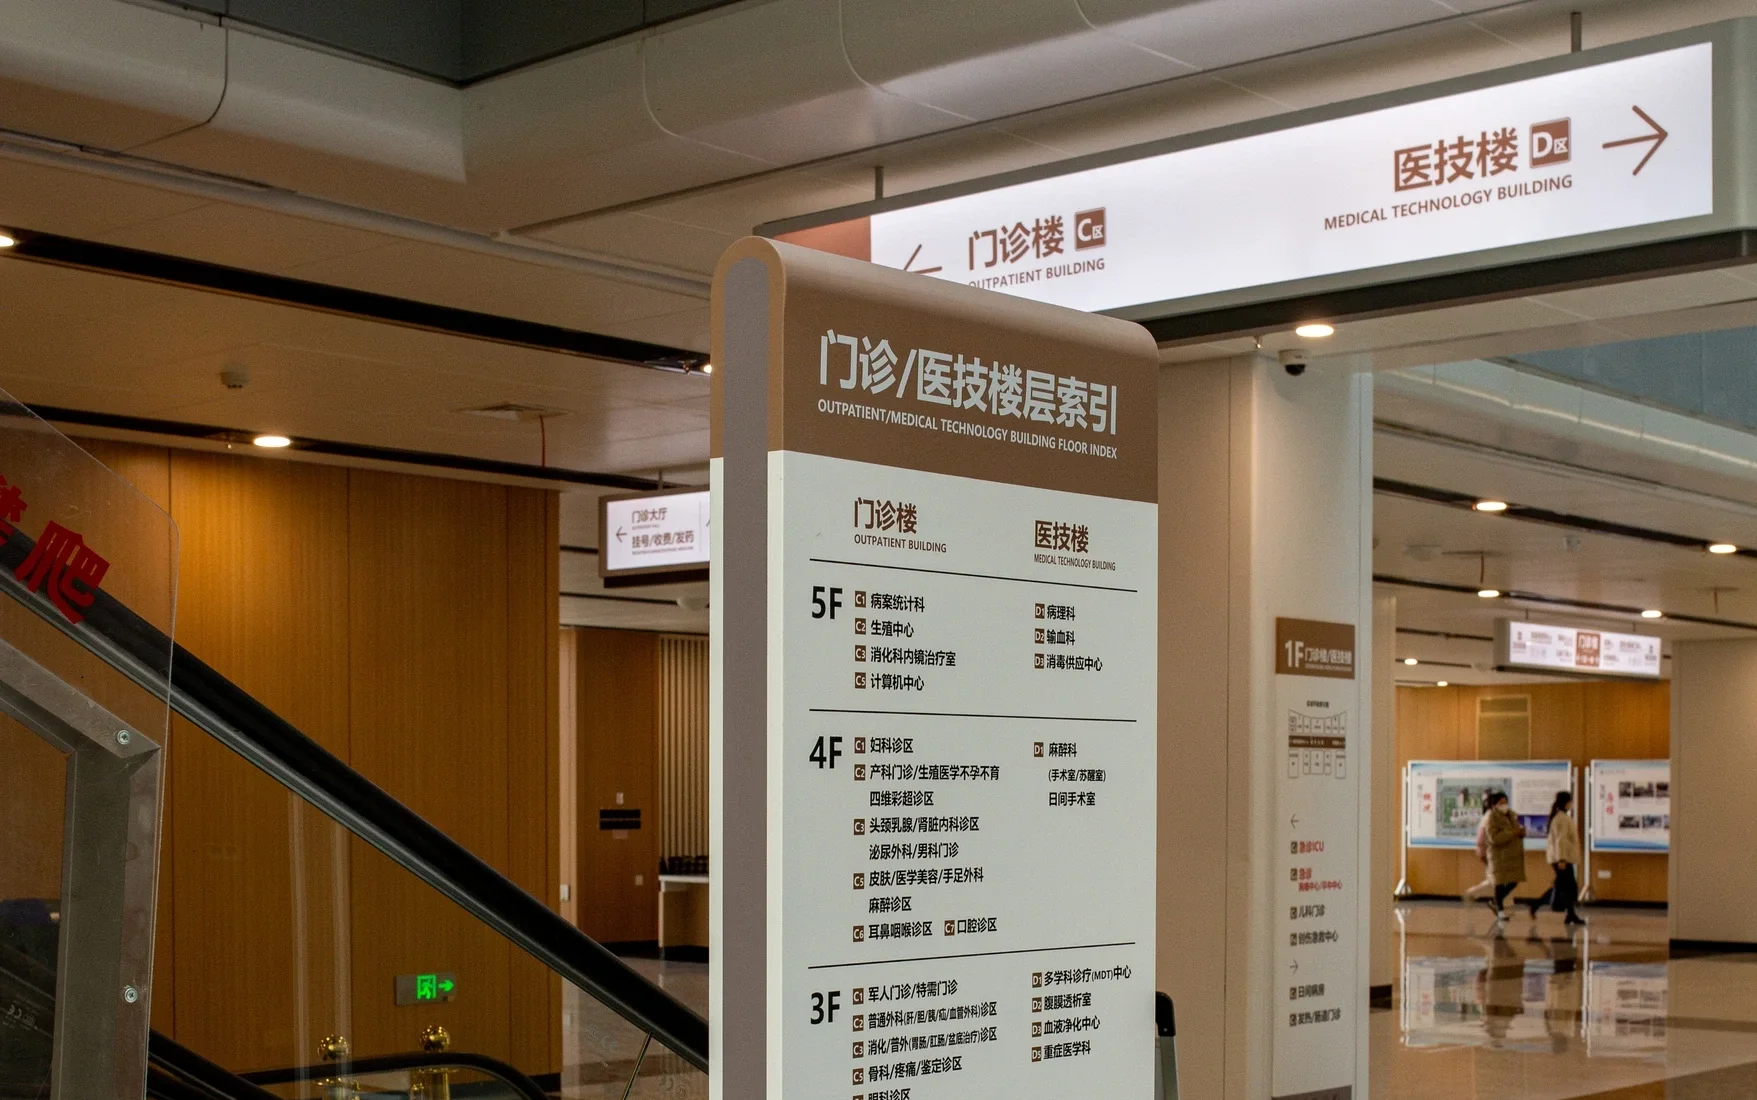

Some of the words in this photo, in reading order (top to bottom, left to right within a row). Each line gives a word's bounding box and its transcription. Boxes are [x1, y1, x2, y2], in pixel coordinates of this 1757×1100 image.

[1394, 128, 1518, 192] 医技楼
[1324, 208, 1387, 230] MEDICAL
[1392, 190, 1492, 218] TECHNOLOGY
[1498, 175, 1572, 200] BUILDING
[968, 215, 1064, 271] 门诊楼
[1046, 258, 1105, 278] BUILDING
[820, 329, 1117, 435] 门诊/医技楼层索引
[818, 399, 938, 430] OUTPATIENT/MEDICAL
[940, 418, 1008, 442] TECHNOLOGY
[1010, 430, 1056, 449] BUILDING
[1058, 438, 1088, 454] FLOOR
[1090, 444, 1118, 459] INDEX
[632, 508, 667, 524] 门诊大厅
[854, 497, 917, 534] 门诊楼
[632, 530, 694, 548] 挂号/收费/发药
[854, 534, 906, 549] OUTPATIENT
[908, 540, 946, 552] BUILDING
[1034, 520, 1088, 554] 医技楼
[1034, 554, 1056, 565] MEDICAL
[1058, 556, 1091, 569] TECHNOLOGY
[1092, 560, 1116, 571] BUILDING
[812, 586, 842, 619] 5F
[870, 593, 925, 612] 病案统计科
[1046, 605, 1076, 621] 病理科
[870, 620, 914, 638] 生殖中心
[1046, 630, 1076, 646] 输血科
[870, 647, 956, 666] 消化科内镜治疗室
[1046, 654, 1102, 672] 消毒供应中心
[1285, 640, 1304, 668] 1F
[870, 674, 924, 691] 计算机中心
[809, 736, 842, 769] 4F
[870, 738, 914, 754] 妇科诊区
[1048, 742, 1077, 757] 麻醉科
[870, 764, 1000, 780] 产科门诊/生殖医学不孕不育
[1048, 769, 1106, 782] (手术室/苏醒室)
[870, 790, 934, 806] 四维彩超诊区
[1049, 792, 1096, 806] 日间手术室
[870, 816, 979, 833] 头颈乳腺/肾脏内科诊区
[870, 842, 959, 860] 泌尿外科/男科门诊
[869, 866, 984, 887] 皮肤/医学美容/手足外科
[868, 896, 912, 914] 麻醉诊区
[868, 922, 932, 940] 耳鼻咽喉诊区
[958, 918, 997, 934] 口腔诊区
[1044, 965, 1132, 986] 多学科诊疗(MDT)中心
[868, 979, 958, 1002] 军人门诊/特需门诊
[810, 991, 840, 1024] 3F
[1044, 1015, 1100, 1034] 血液净化中心
[1044, 1040, 1091, 1060] 重症医学科
[868, 1056, 962, 1082] 骨科/疼痛/鉴定诊区
